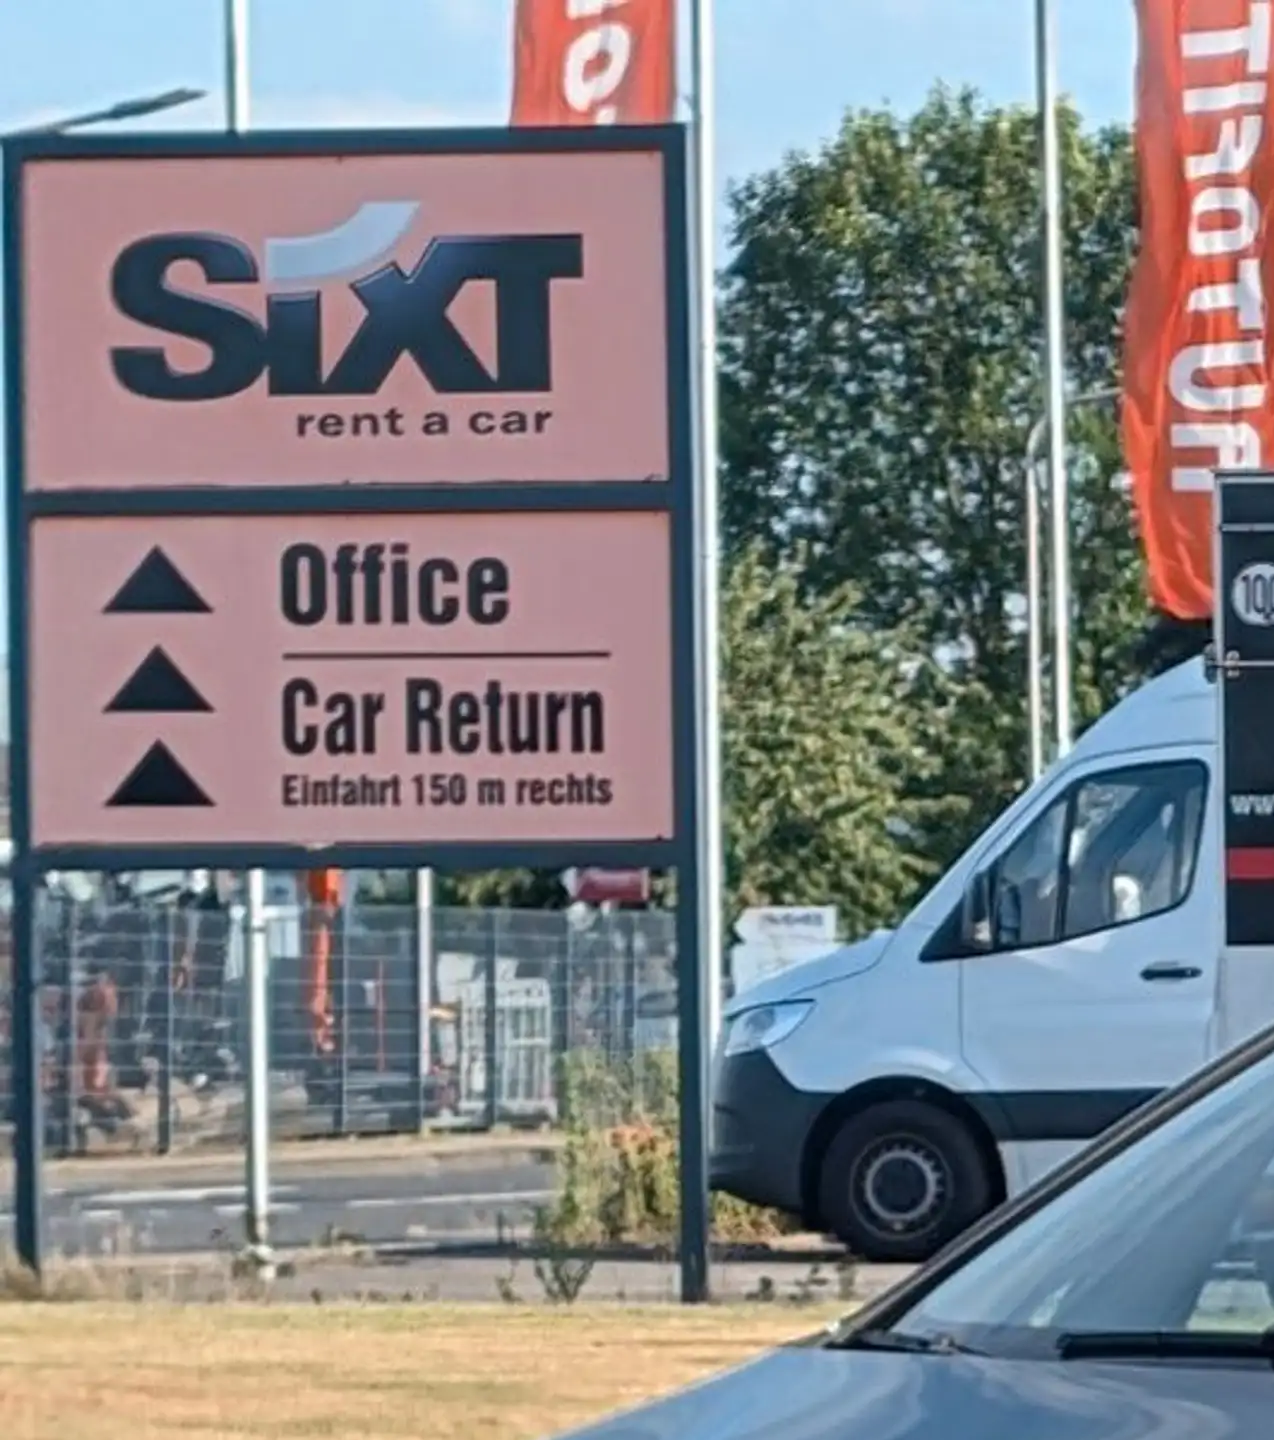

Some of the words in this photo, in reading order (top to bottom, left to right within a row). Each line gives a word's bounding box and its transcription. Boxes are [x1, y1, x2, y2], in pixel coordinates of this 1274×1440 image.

[109, 200, 584, 403] SIXT
[296, 409, 404, 438] rent
[422, 412, 450, 437] a
[468, 410, 554, 437] car
[280, 542, 511, 626] Office
[281, 677, 385, 757] Car
[405, 676, 606, 756] Return
[282, 774, 401, 808] Einfahrt
[414, 774, 468, 807] 150
[478, 780, 506, 806] m
[515, 771, 613, 807] rechts
